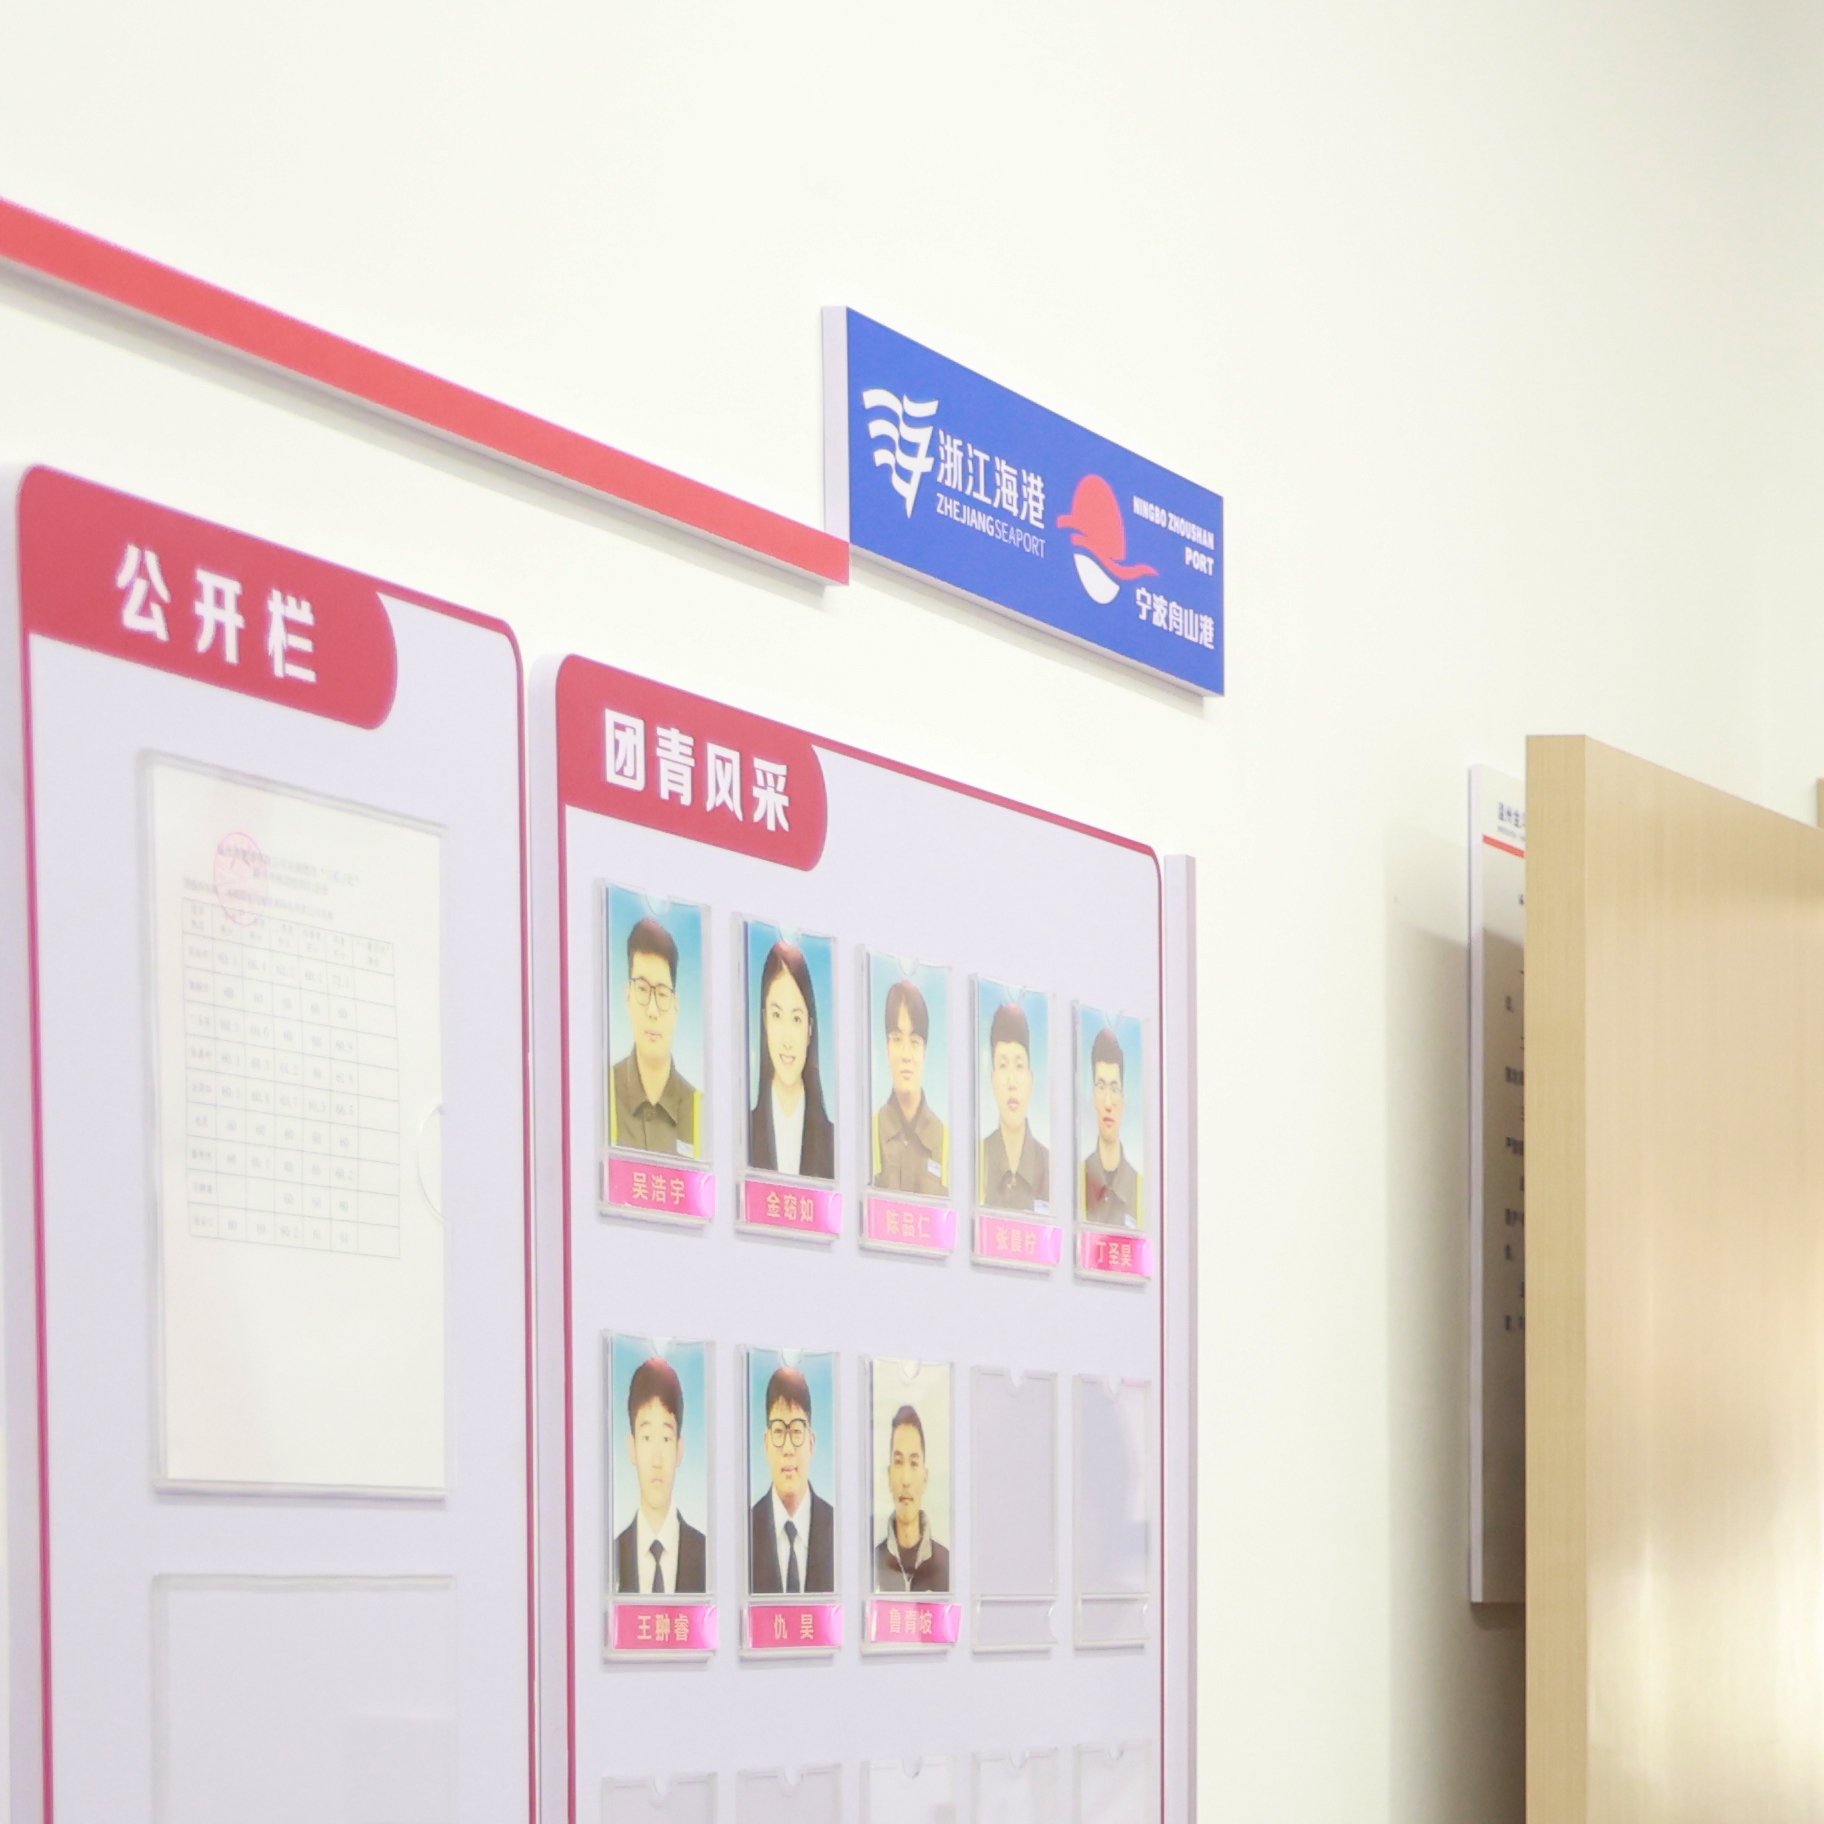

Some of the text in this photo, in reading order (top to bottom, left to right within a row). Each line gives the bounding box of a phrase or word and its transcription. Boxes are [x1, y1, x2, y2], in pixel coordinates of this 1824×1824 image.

[936, 429, 1046, 529] 浙江海港
[1133, 495, 1215, 550] NINGBO ZHOUSHAN
[1184, 546, 1214, 576] PORT
[116, 543, 317, 683] 公开栏
[1135, 587, 1215, 650] 宁波舟山港
[605, 708, 789, 832] 团青风采
[632, 1172, 686, 1206] 吴浩宇
